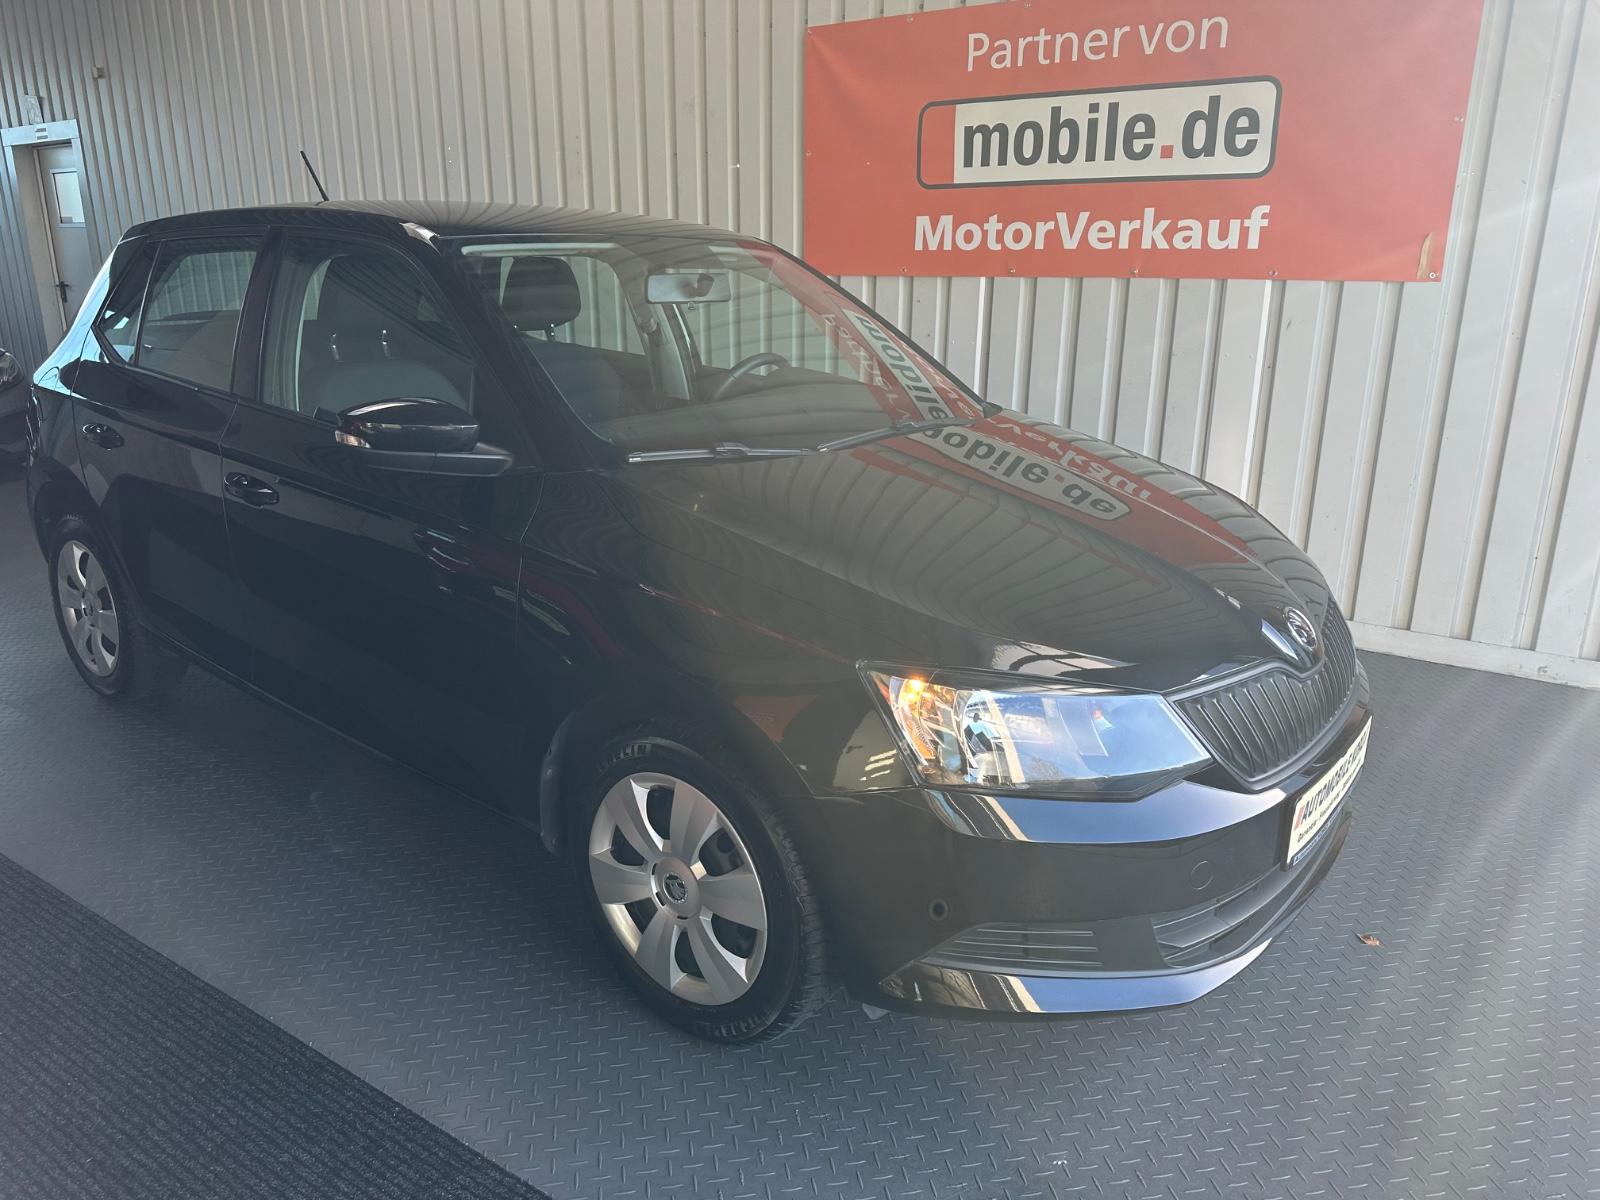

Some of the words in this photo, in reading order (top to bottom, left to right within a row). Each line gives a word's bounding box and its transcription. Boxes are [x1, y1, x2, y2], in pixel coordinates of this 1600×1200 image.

[966, 26, 1130, 72] Partner
[1137, 15, 1229, 55] von
[962, 95, 1260, 168] mobile.de
[914, 205, 1271, 252] MotorVerkauf
